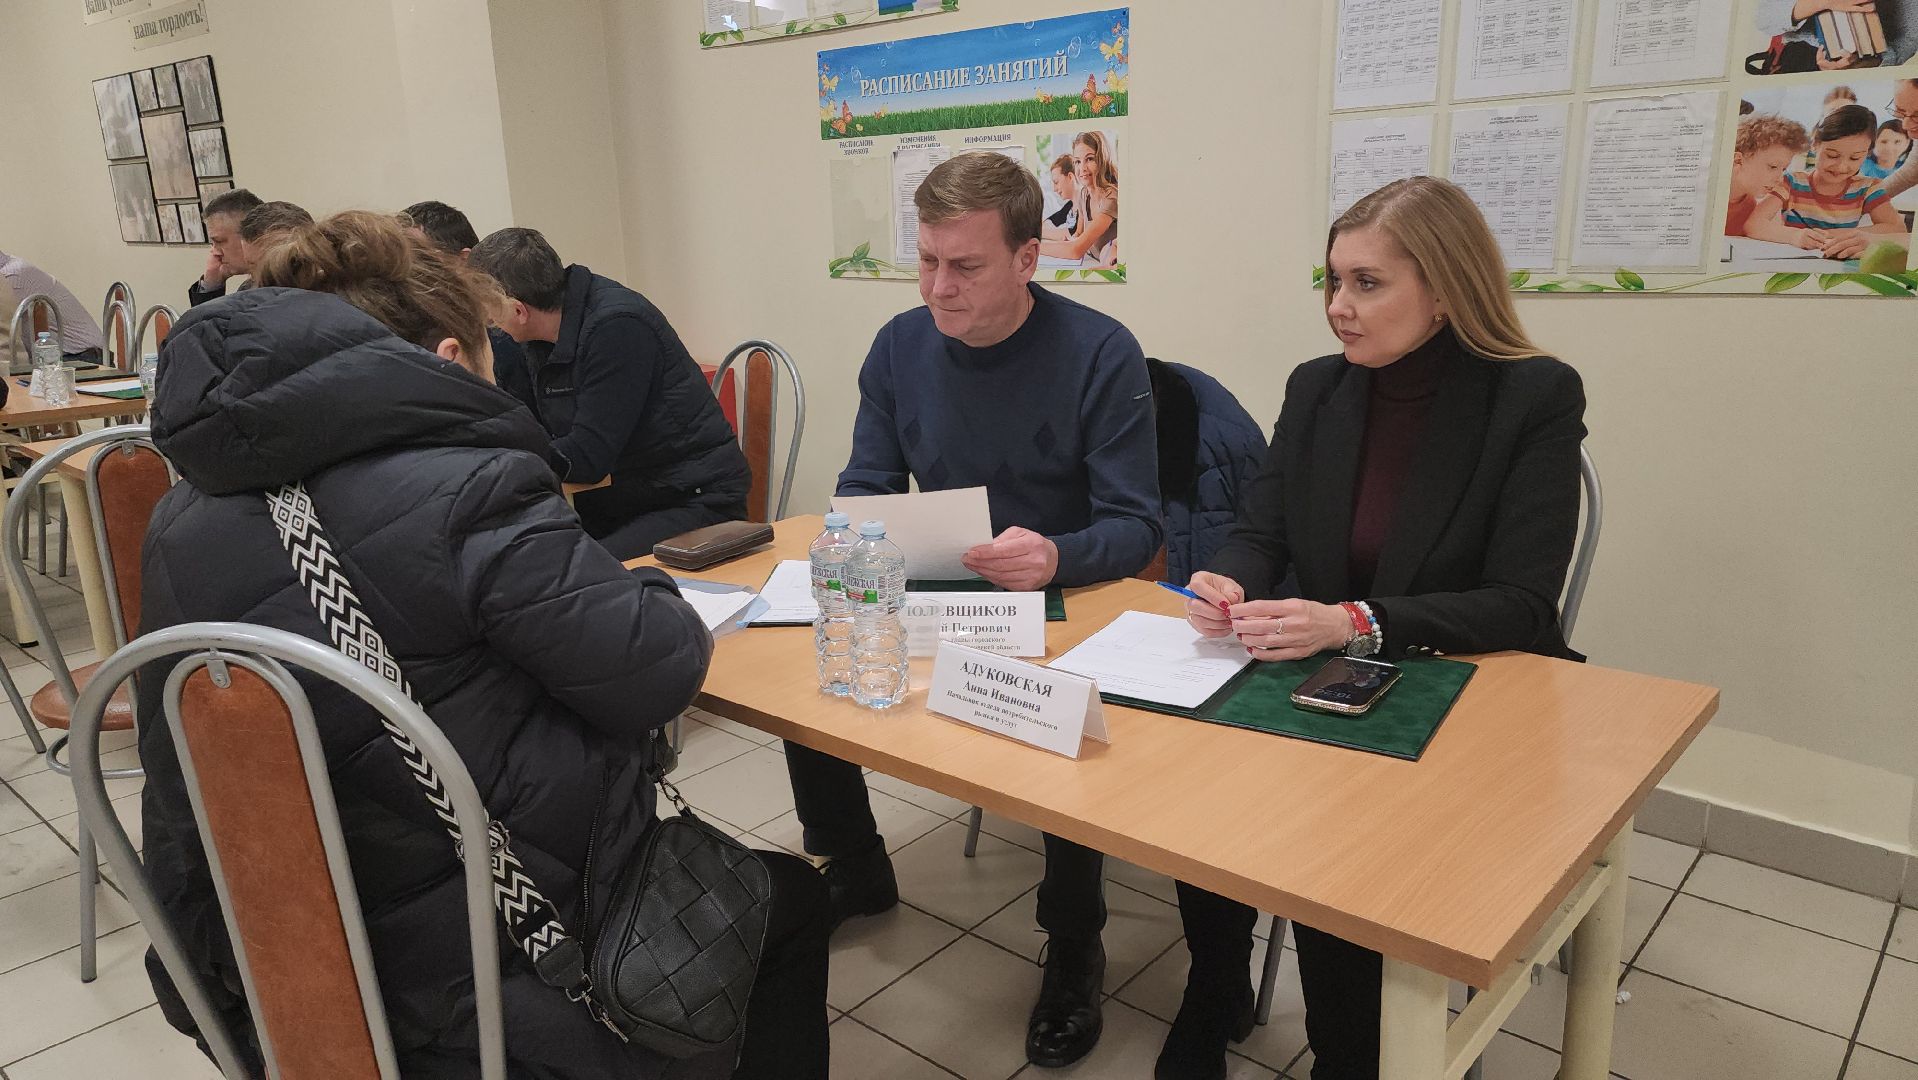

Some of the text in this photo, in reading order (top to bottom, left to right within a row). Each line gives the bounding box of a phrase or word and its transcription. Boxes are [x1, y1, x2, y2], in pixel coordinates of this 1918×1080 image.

[133, 2, 204, 40] наша гордость!
[860, 49, 1069, 98] РАСПИСАНИЕ ЗАНЯТИЙ
[839, 139, 874, 149] РАСПИСАНИЕ
[900, 134, 937, 143] ИЗМЕНЕНИЯ
[964, 133, 1012, 144] ИНФОРМАЦИЯ
[907, 605, 1017, 618] ОЛВЩИКОВ
[952, 622, 1011, 635] Петрович
[960, 660, 1053, 698] АДУКОВСКАЯ
[946, 689, 980, 706] Начальник
[962, 680, 1041, 713] Анна Ивановна
[1000, 718, 1018, 729] услуг
